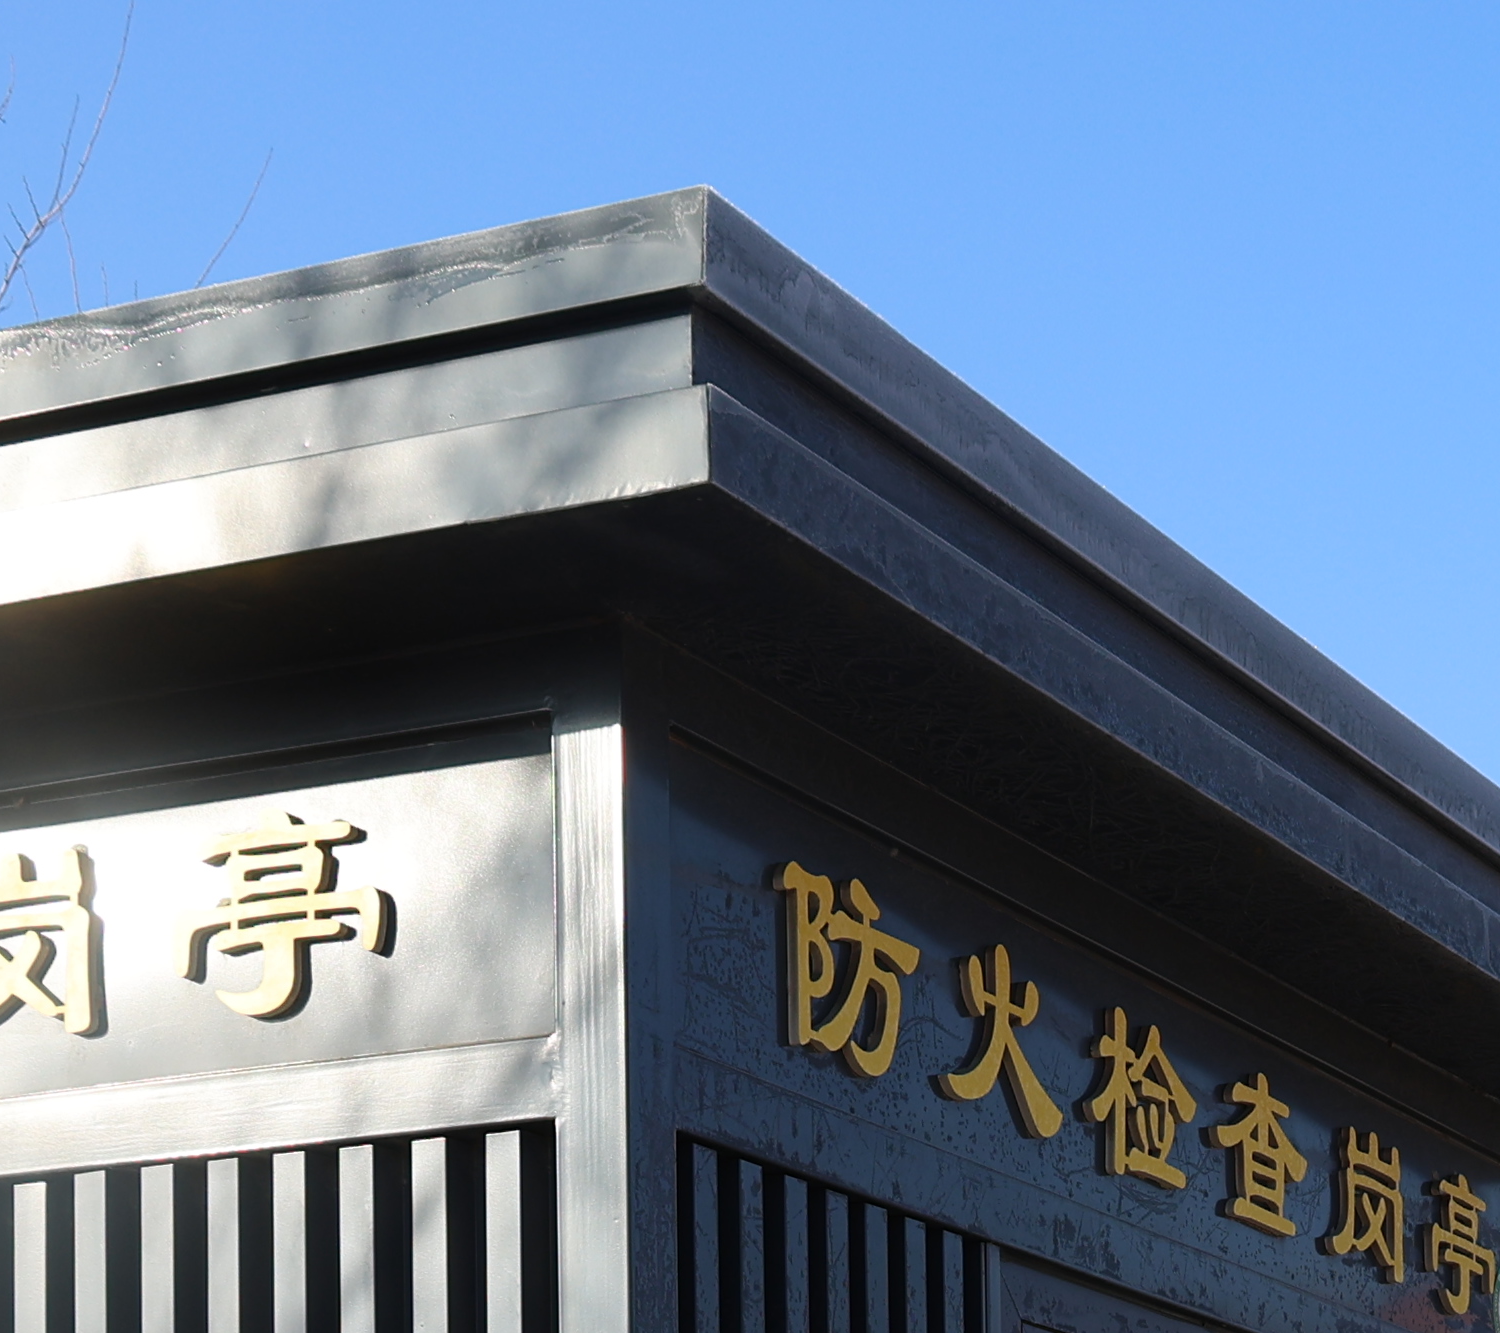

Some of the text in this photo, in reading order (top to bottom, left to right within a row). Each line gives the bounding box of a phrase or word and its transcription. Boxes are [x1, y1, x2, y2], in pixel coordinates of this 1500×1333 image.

[772, 860, 1496, 1315] 防火检查岗亭
